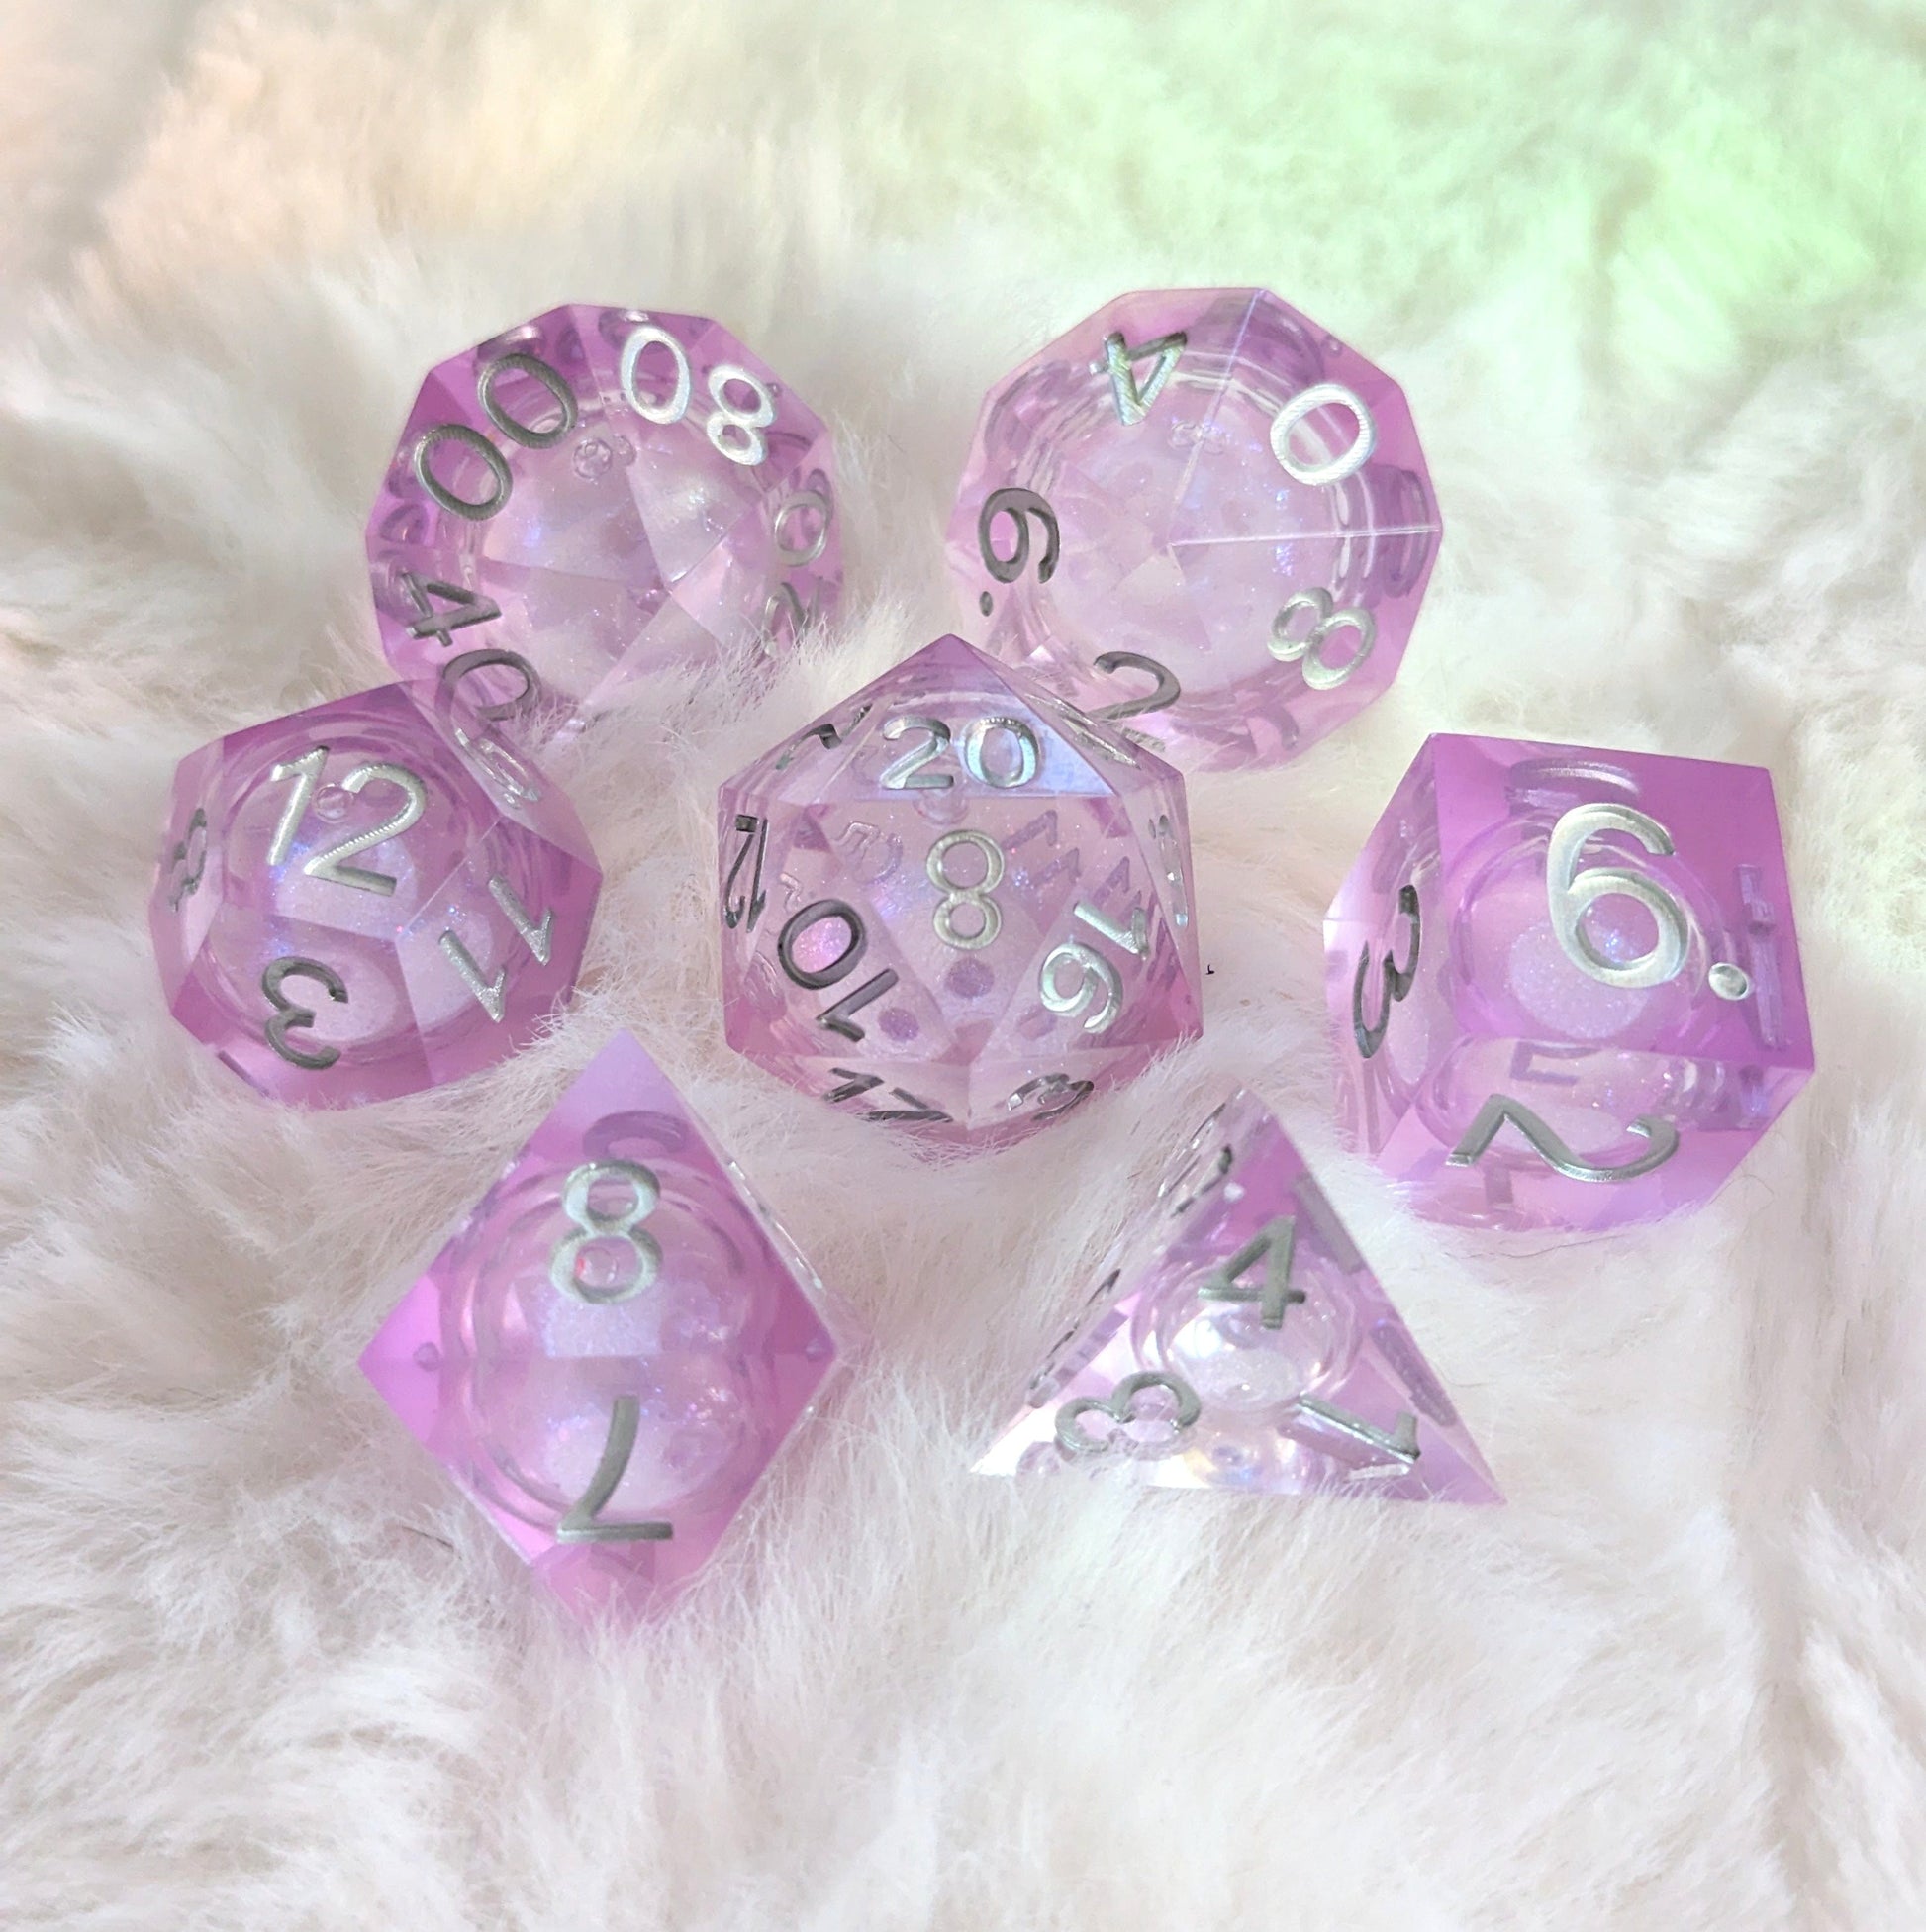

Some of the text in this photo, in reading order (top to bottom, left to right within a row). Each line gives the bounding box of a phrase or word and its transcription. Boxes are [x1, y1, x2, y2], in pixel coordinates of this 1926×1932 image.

[414, 353, 578, 521] 00
[621, 325, 777, 465] 80
[1090, 331, 1188, 426] 4
[1270, 384, 1377, 486] 0
[1266, 587, 1376, 690] 8
[880, 716, 1041, 790] 20
[267, 745, 428, 897] 12
[438, 875, 556, 1023] 11
[926, 829, 1005, 950] 8
[261, 956, 349, 1071] 3
[777, 899, 900, 1044] 10
[1039, 901, 1152, 1035] 16
[1353, 884, 1422, 1059] 3
[1445, 1094, 1681, 1183] 2
[549, 1159, 663, 1304] 8
[1197, 1215, 1307, 1330] 4
[556, 1394, 675, 1546] 7
[1054, 1370, 1202, 1455] 3
[1294, 1394, 1422, 1465] 1
